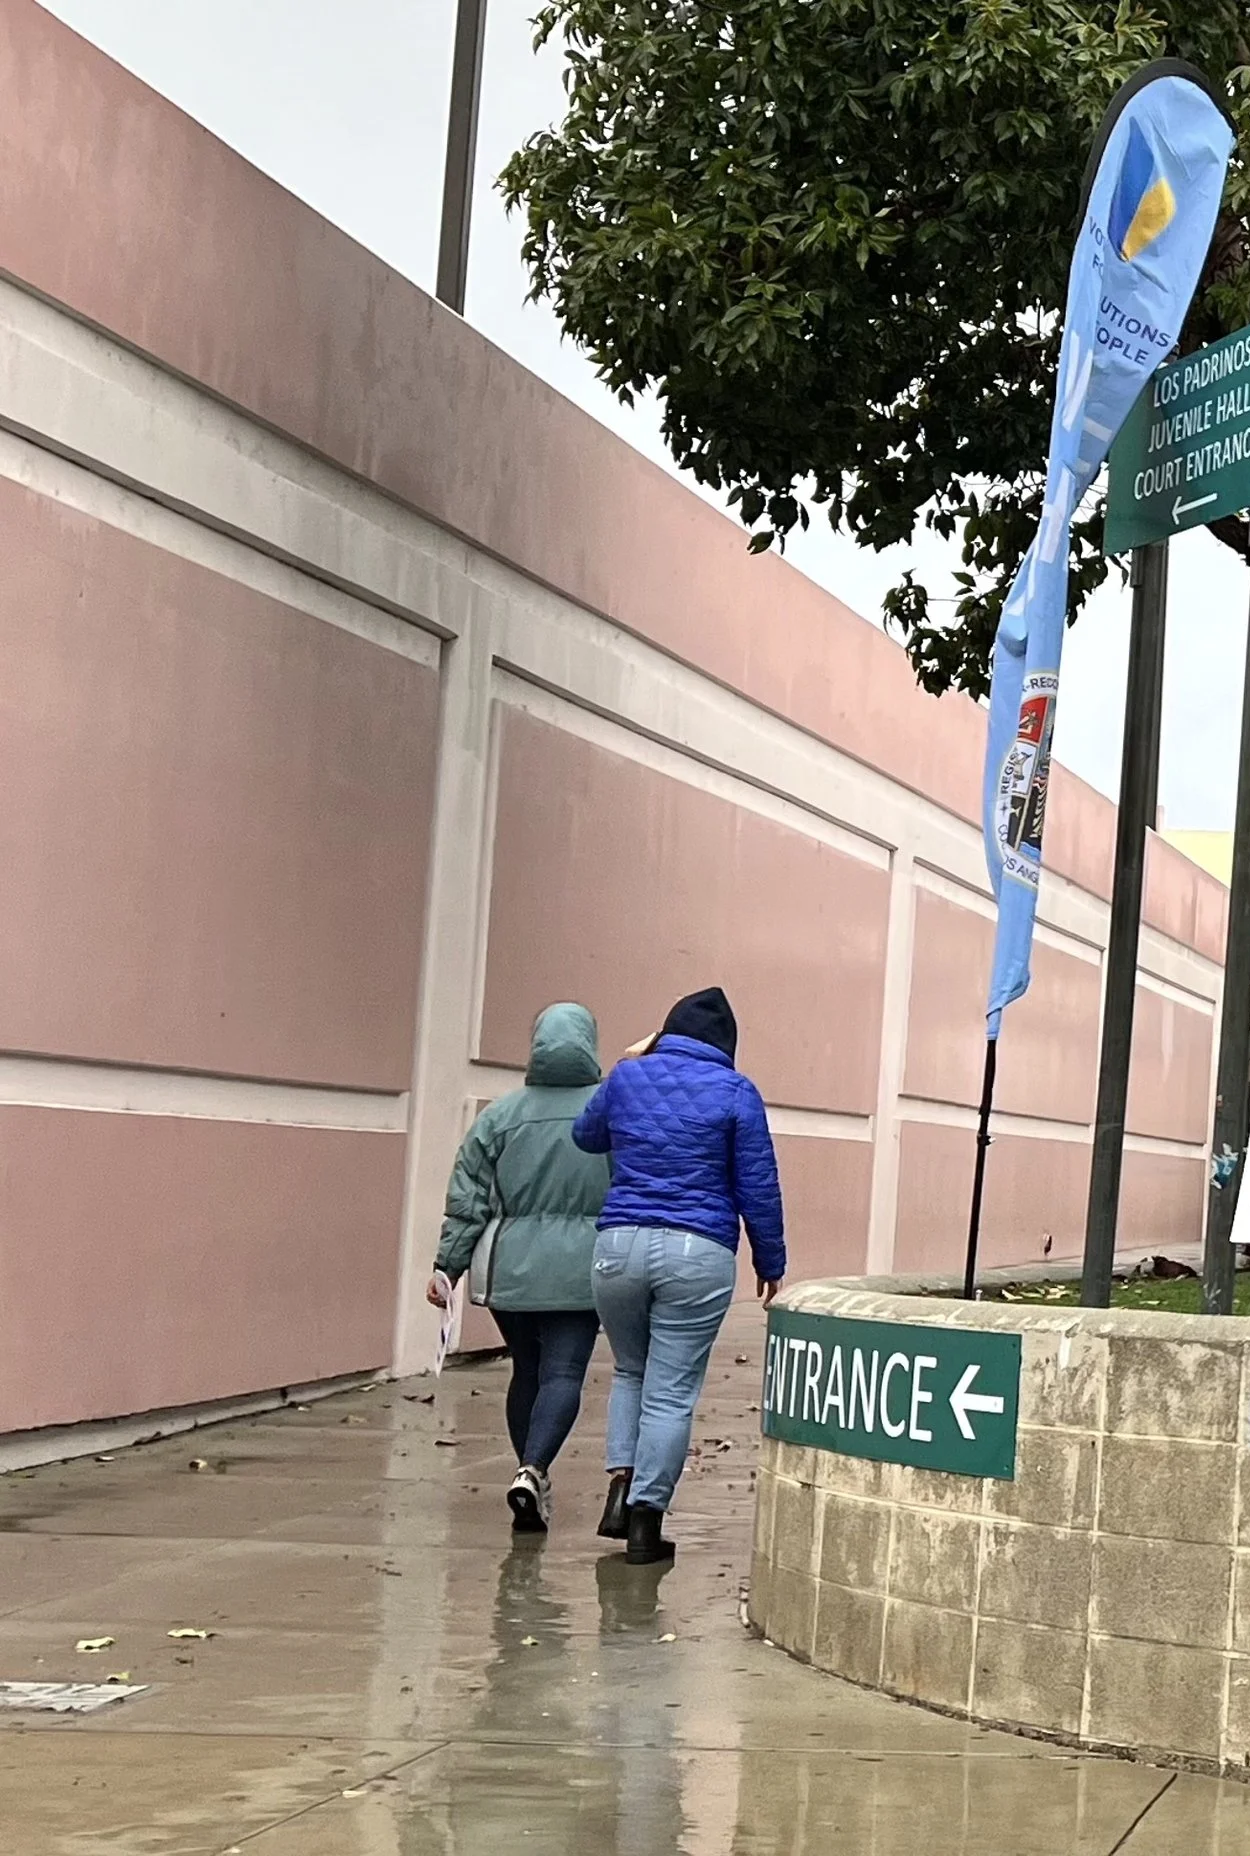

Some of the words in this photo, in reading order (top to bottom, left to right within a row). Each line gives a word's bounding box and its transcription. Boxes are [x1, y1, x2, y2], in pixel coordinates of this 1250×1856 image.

[1096, 322, 1149, 365] OPLE
[1100, 296, 1171, 347] UTIONS
[1154, 371, 1180, 408] LOS
[1148, 400, 1213, 453] JUVENILE
[1216, 383, 1250, 425] HALL
[1134, 457, 1183, 501] COURT
